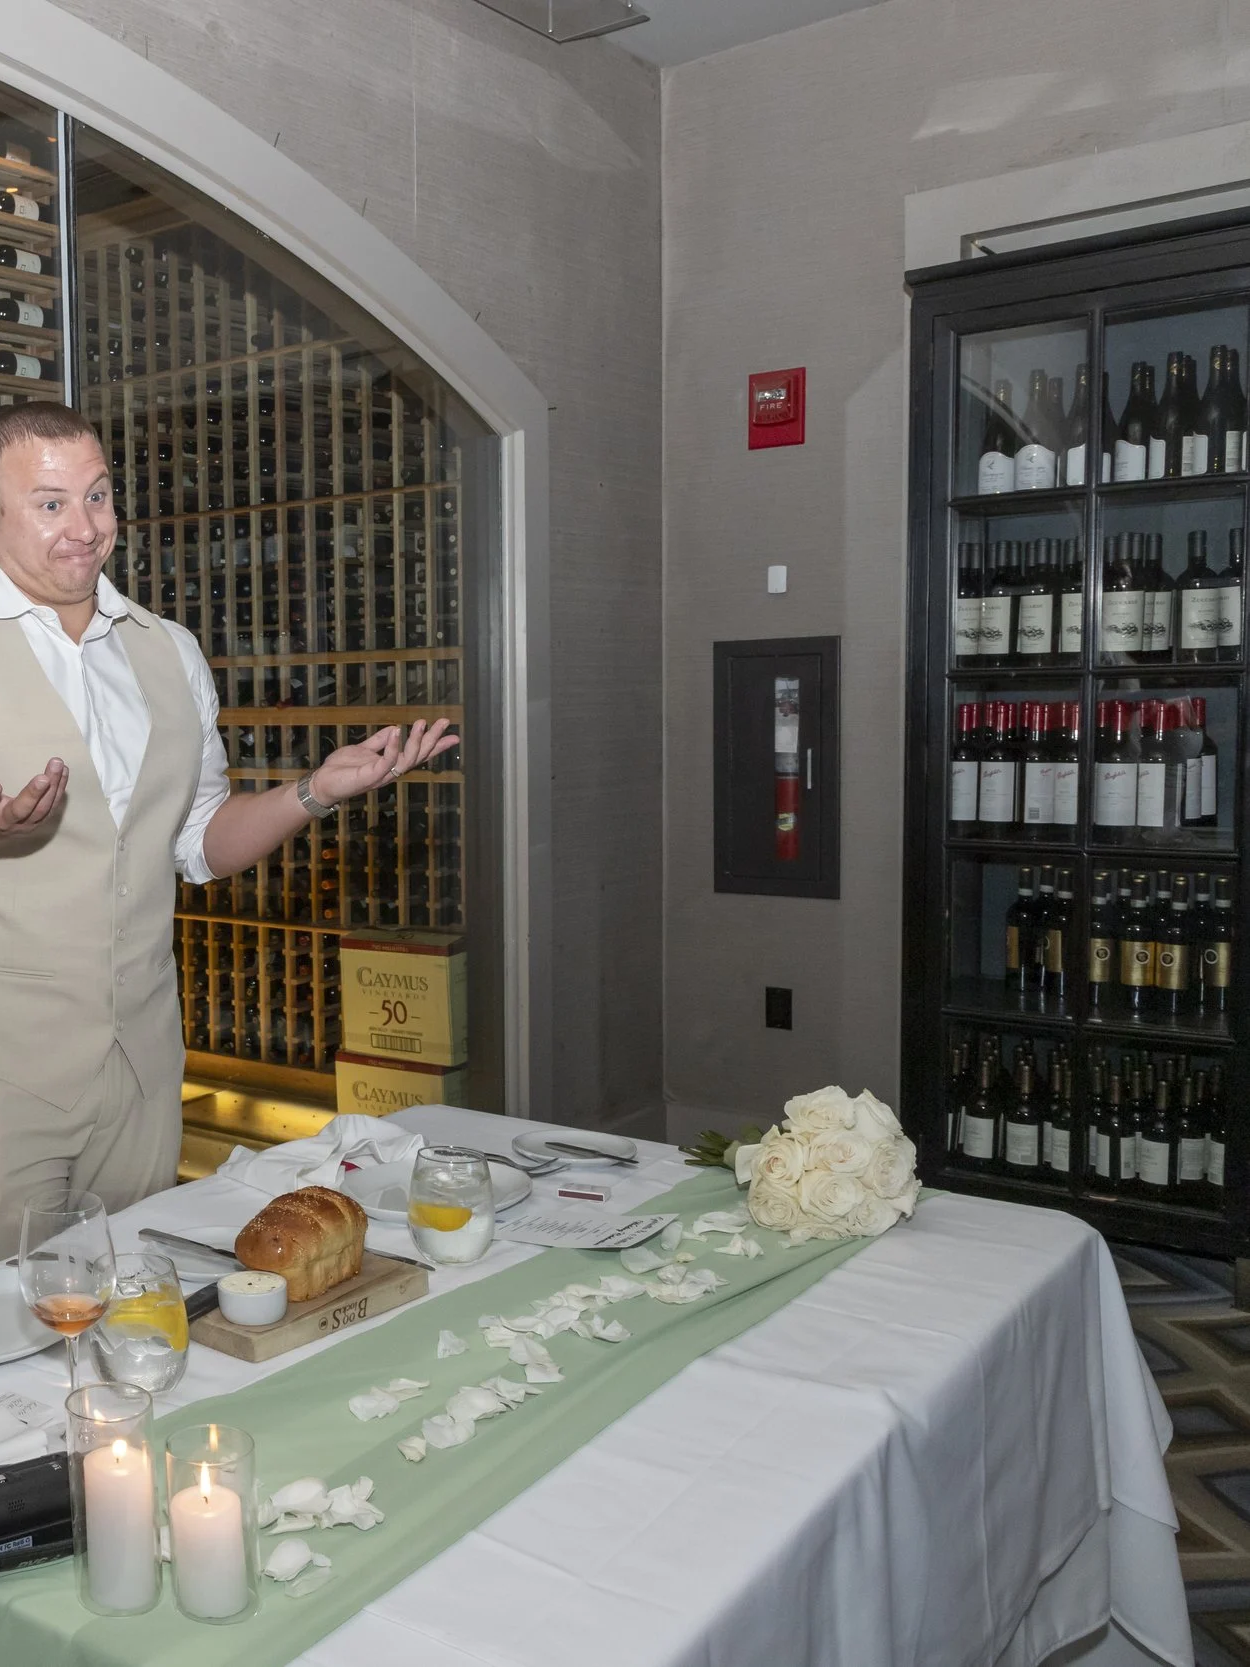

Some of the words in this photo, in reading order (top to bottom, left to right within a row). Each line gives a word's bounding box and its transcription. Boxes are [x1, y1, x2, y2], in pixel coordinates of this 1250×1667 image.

[760, 402, 783, 411] FIRE
[357, 966, 429, 992] CAYMUS
[361, 988, 427, 1001] VINEYARDS
[381, 999, 408, 1026] 50
